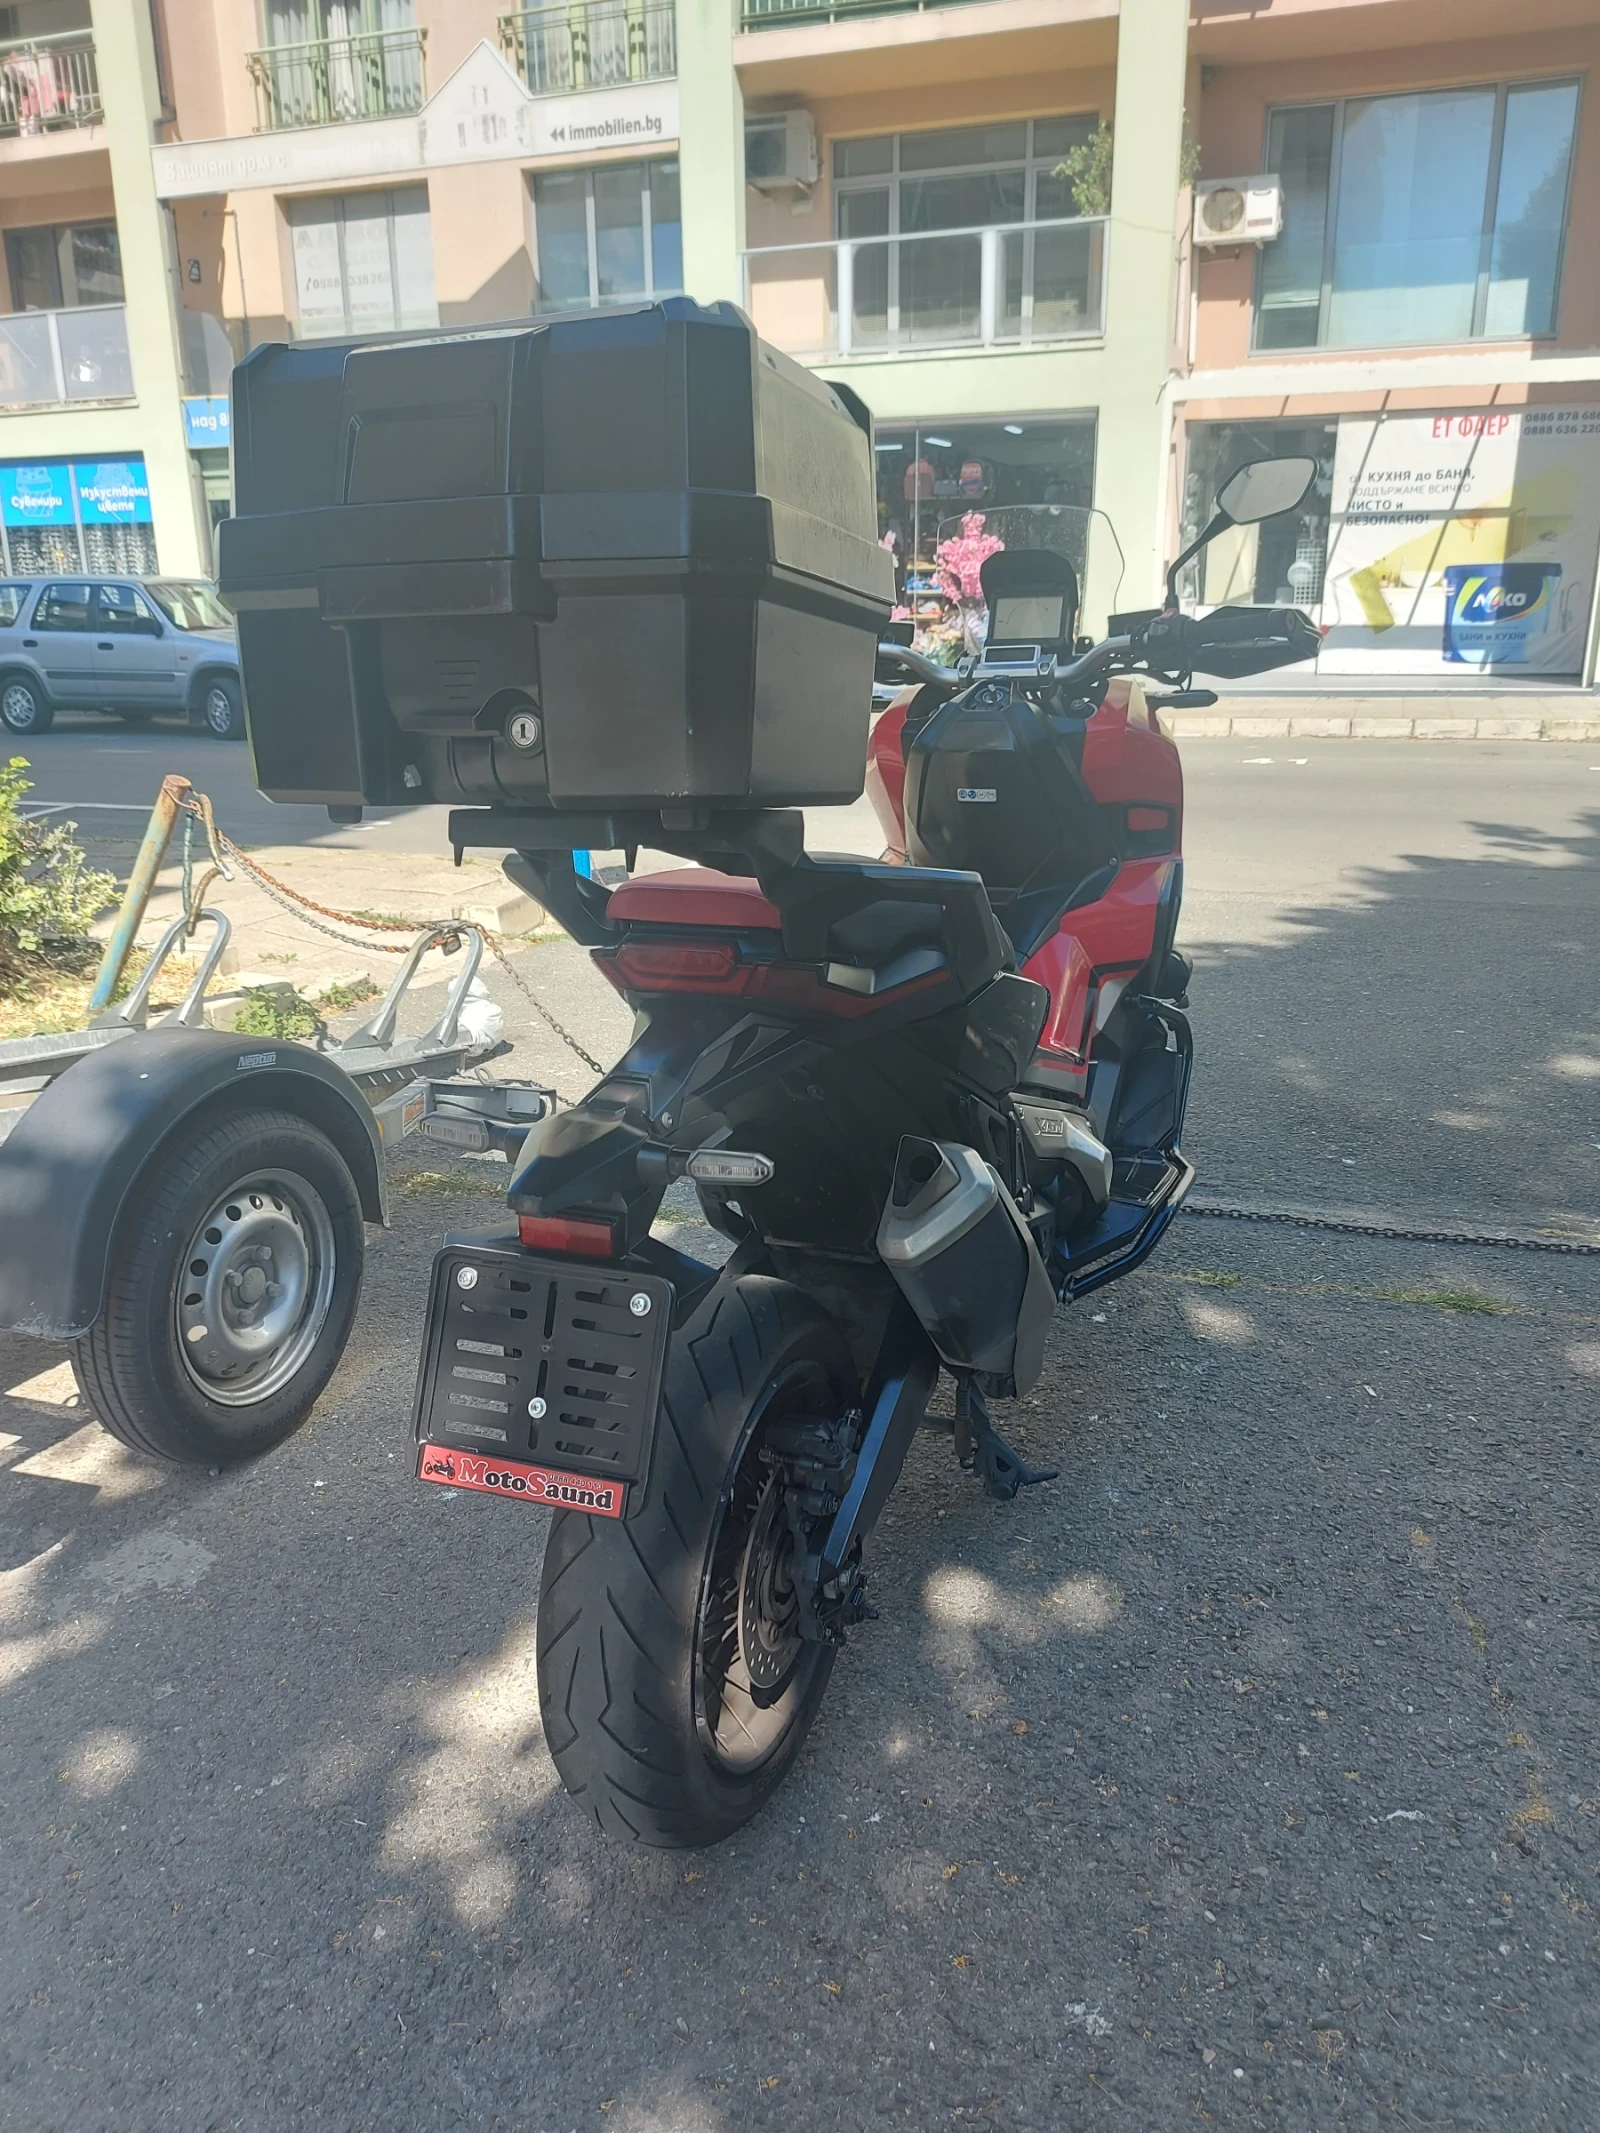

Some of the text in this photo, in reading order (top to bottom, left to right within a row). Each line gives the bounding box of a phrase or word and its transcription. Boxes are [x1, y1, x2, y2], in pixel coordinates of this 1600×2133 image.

[568, 115, 662, 141] immobilien.bg
[191, 415, 217, 431] над
[1525, 413, 1554, 423] 0886
[1557, 411, 1579, 422] 878
[1432, 413, 1509, 438] ЕТ ФАЕР
[1524, 425, 1553, 436] 0888
[1556, 424, 1577, 435] 636
[1368, 471, 1411, 483] КУХНЯ
[1415, 472, 1431, 483] до
[1436, 468, 1475, 481] БАНЯ,
[80, 485, 149, 501] Изкуствени
[11, 495, 63, 510] Сувенири
[97, 500, 134, 513] цветя
[1349, 499, 1403, 511] ЧИСТО и
[1345, 513, 1430, 527] БЕЗОПАСНО!
[1459, 632, 1483, 641] БАНИ
[1495, 631, 1527, 641] КУХНИ
[236, 1051, 277, 1069] Neptun
[458, 1457, 613, 1511] MotoSaund
